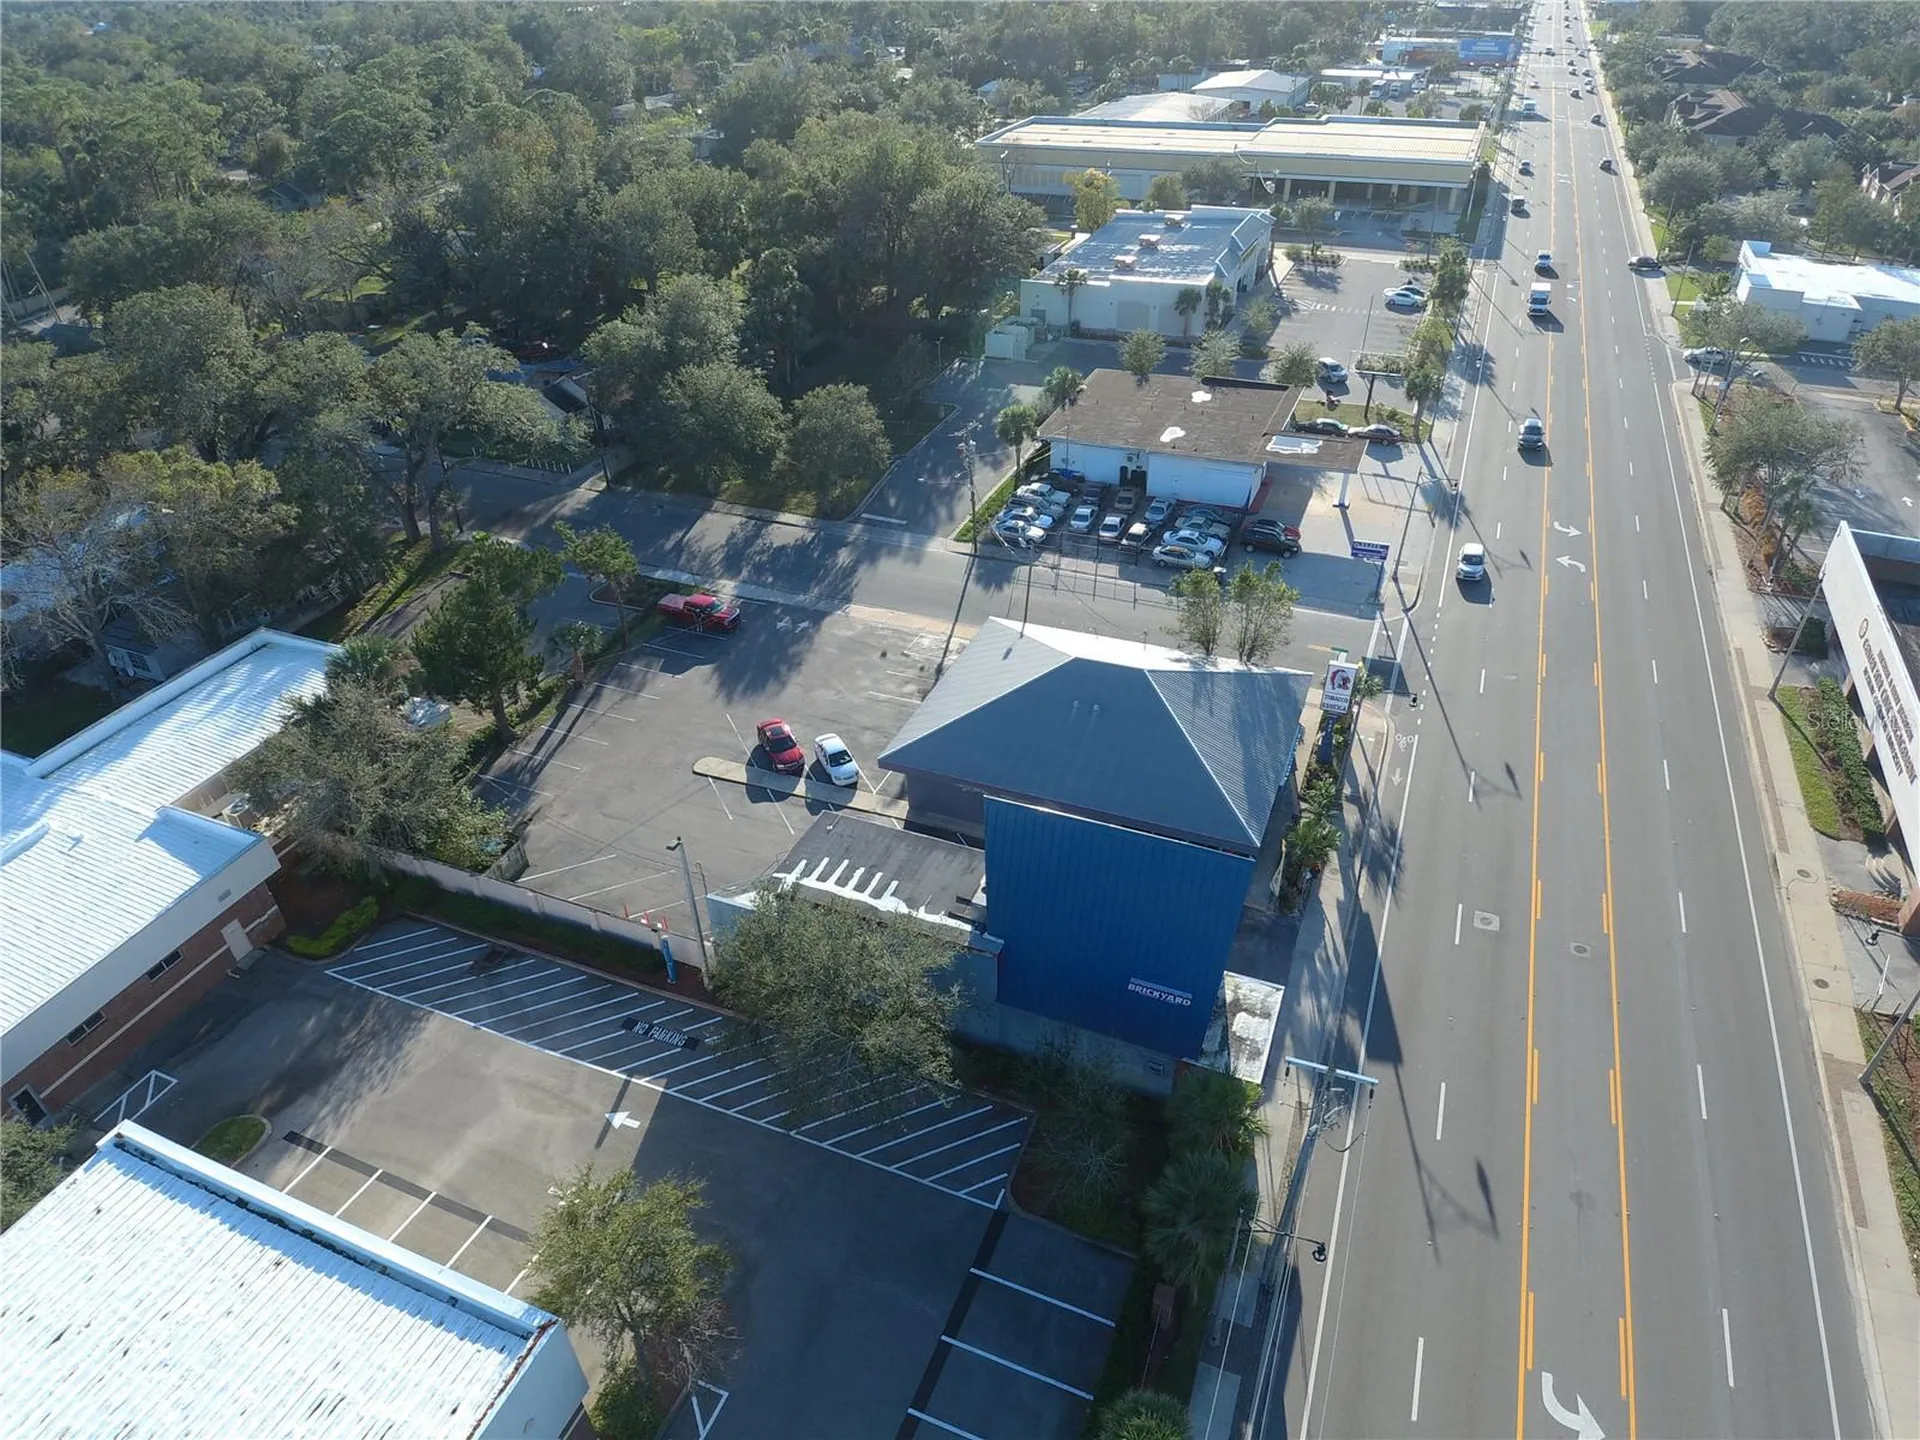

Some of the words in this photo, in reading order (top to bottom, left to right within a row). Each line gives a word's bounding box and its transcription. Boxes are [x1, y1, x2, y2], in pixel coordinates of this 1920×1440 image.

[1127, 983, 1191, 1006] BRICKYARD
[632, 1021, 649, 1034] NO
[648, 1026, 688, 1047] PARKING
